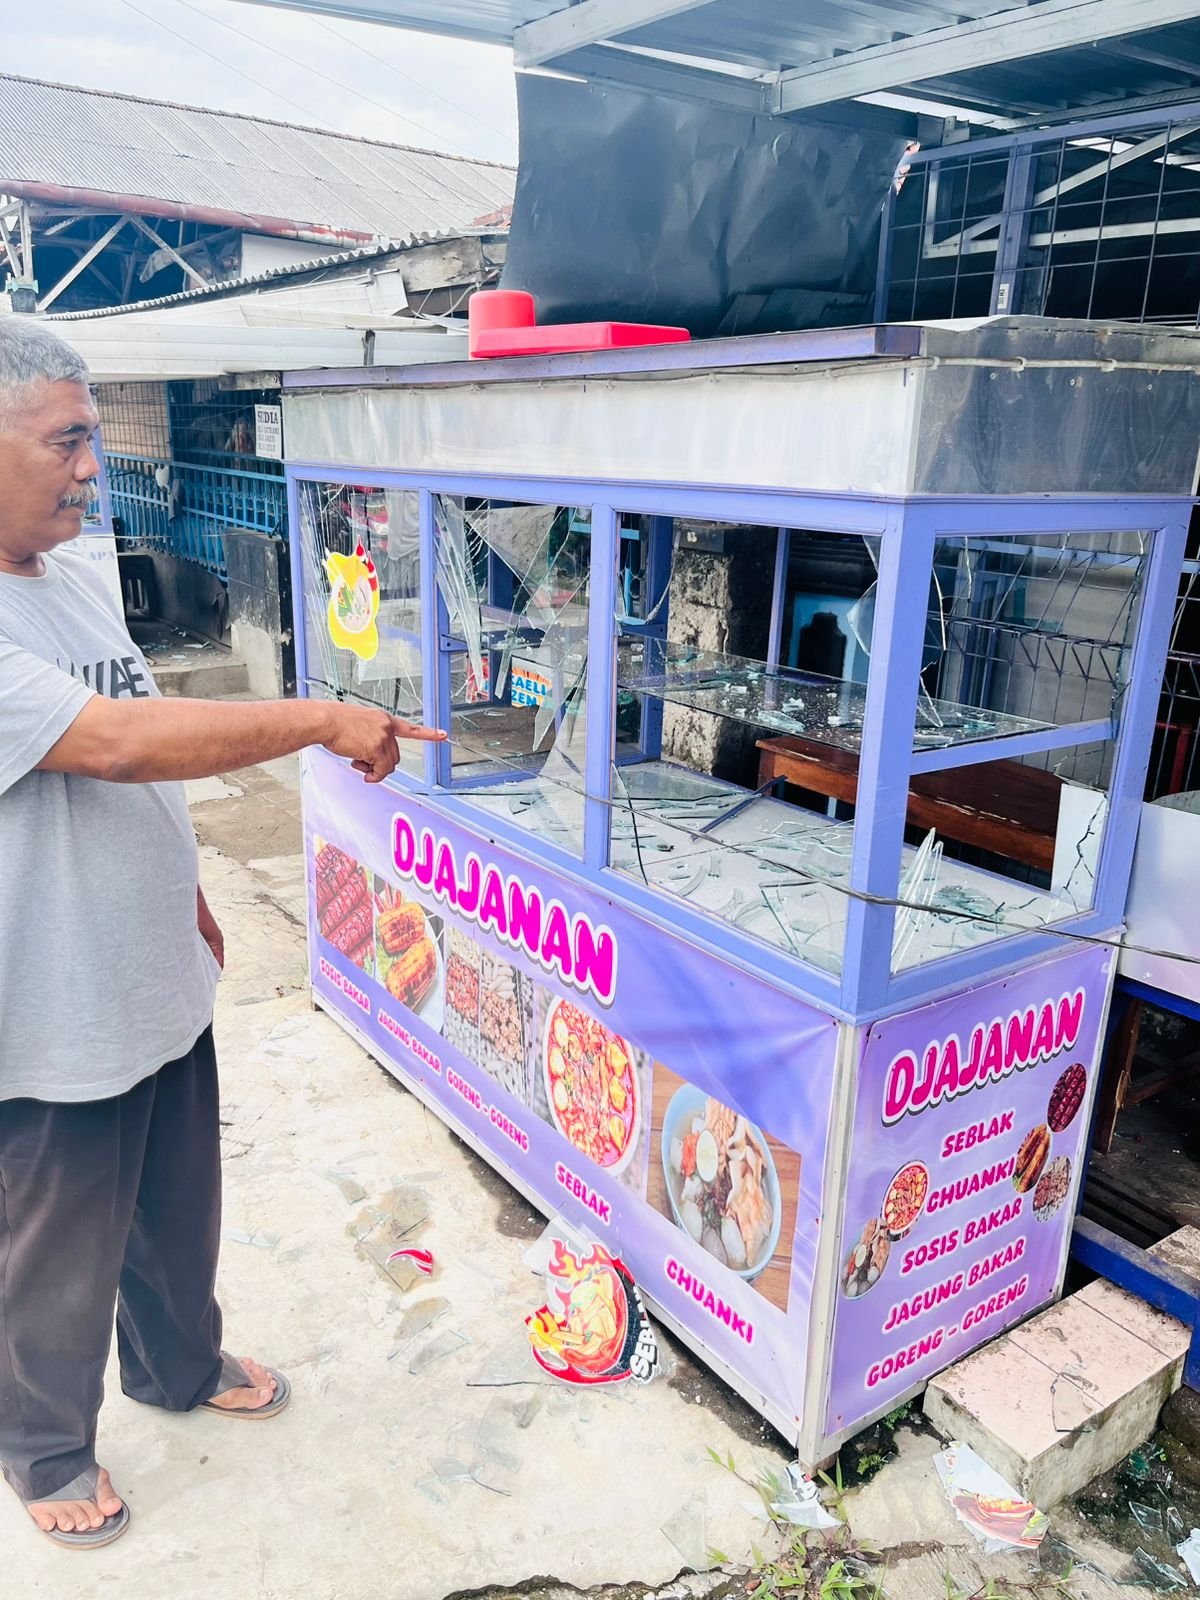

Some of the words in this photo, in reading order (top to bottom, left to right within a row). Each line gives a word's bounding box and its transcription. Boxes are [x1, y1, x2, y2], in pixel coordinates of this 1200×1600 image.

[257, 411, 279, 424] SEDIA
[393, 816, 614, 998] DJAJANAN
[320, 958, 342, 988] SOSIS
[342, 977, 370, 1012] BAKAR
[378, 1010, 411, 1047] JAGUNG
[411, 1037, 442, 1072] BAKAR
[884, 991, 1083, 1118] DJAJANAN
[446, 1068, 481, 1110] GORENG
[490, 1106, 529, 1152] GORENG
[942, 1110, 1014, 1158] SEBLAK
[556, 1164, 611, 1223] SEBLAK
[926, 1156, 1016, 1213] CHUANKI
[901, 1229, 959, 1274] SOSIS
[963, 1197, 1023, 1245] BAKAR
[665, 1256, 755, 1344] CHUANKI
[884, 1273, 964, 1331] JAGUNG
[967, 1238, 1025, 1287] BAKAR
[866, 1329, 944, 1387] GORENG
[962, 1276, 1028, 1331] GORENG
